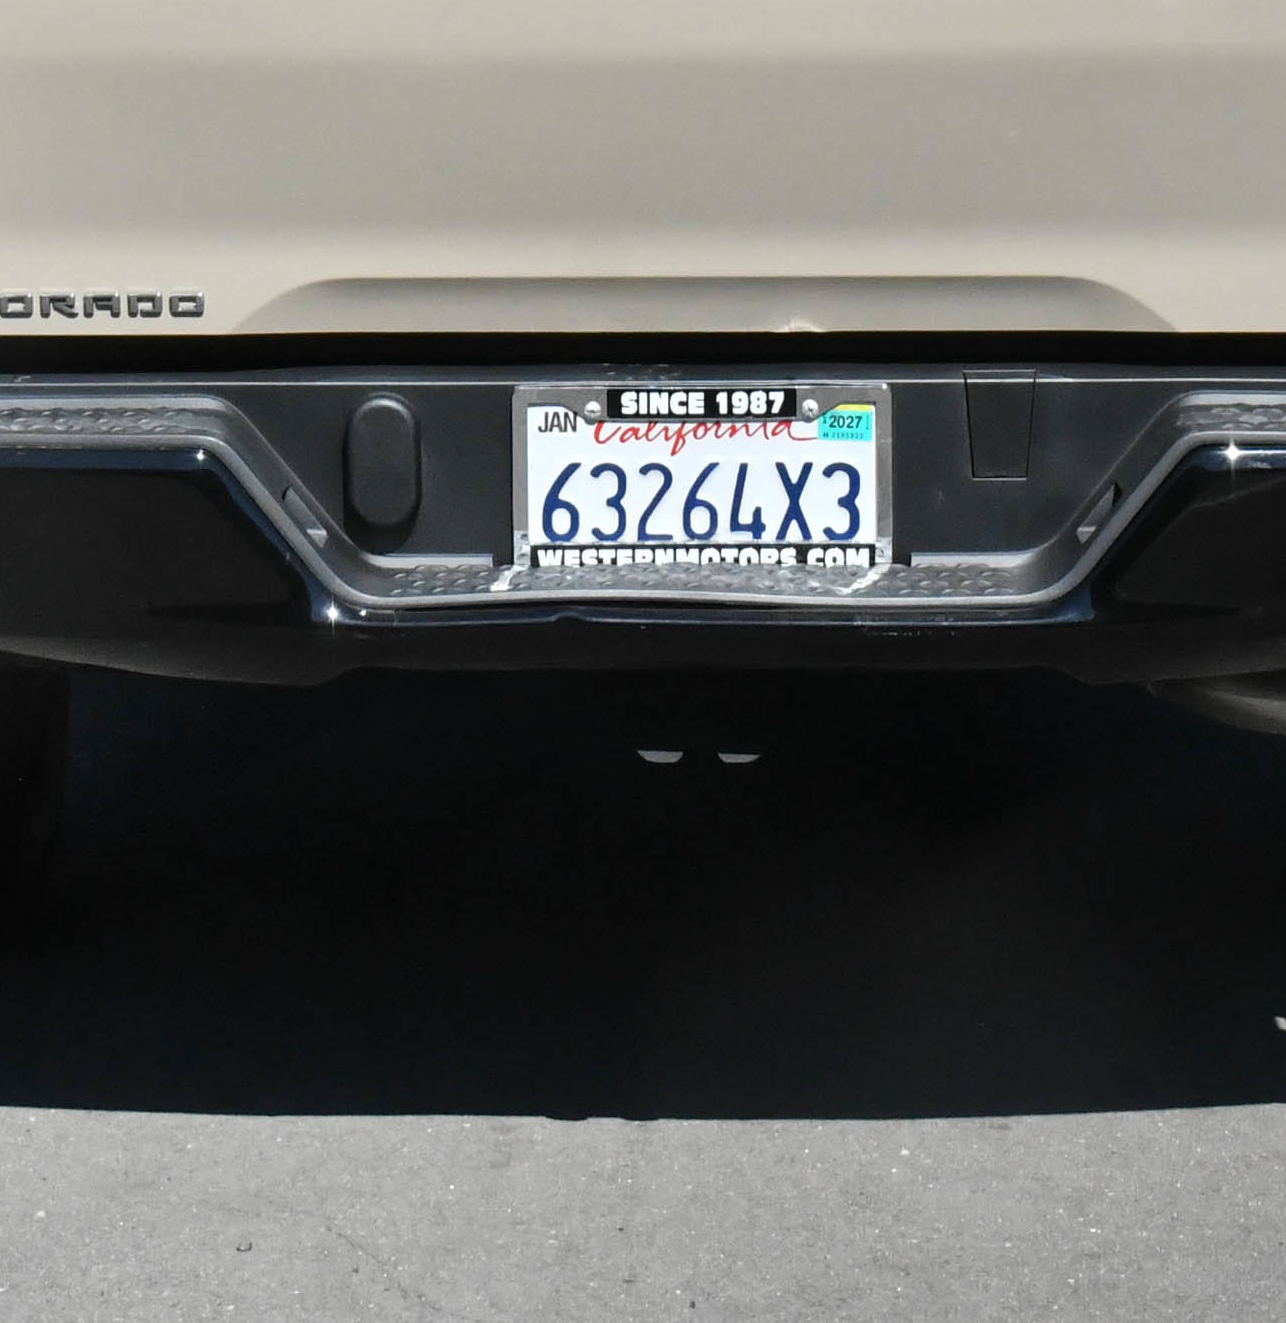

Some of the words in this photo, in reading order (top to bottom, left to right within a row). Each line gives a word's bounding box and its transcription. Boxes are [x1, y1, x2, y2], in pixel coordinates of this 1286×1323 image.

[620, 390, 705, 416] SINCE
[716, 390, 785, 416] 1987
[537, 411, 578, 433] JAN
[828, 414, 863, 429] 2027
[542, 462, 861, 542] 63264X3
